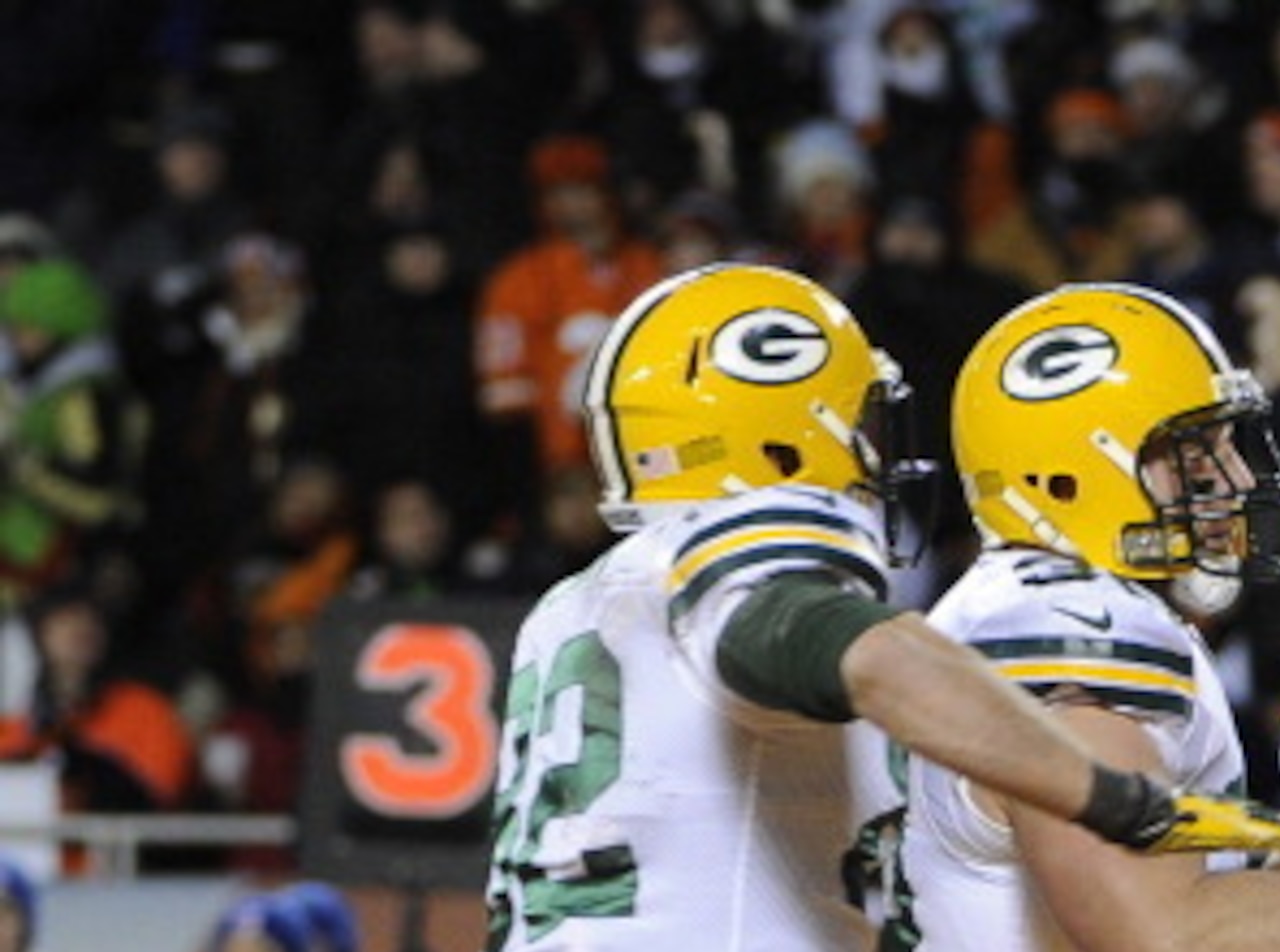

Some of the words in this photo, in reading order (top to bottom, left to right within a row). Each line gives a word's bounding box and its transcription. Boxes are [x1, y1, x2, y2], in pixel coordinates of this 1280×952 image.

[711, 308, 829, 384] G
[1002, 324, 1118, 399] G
[341, 622, 498, 818] 3
